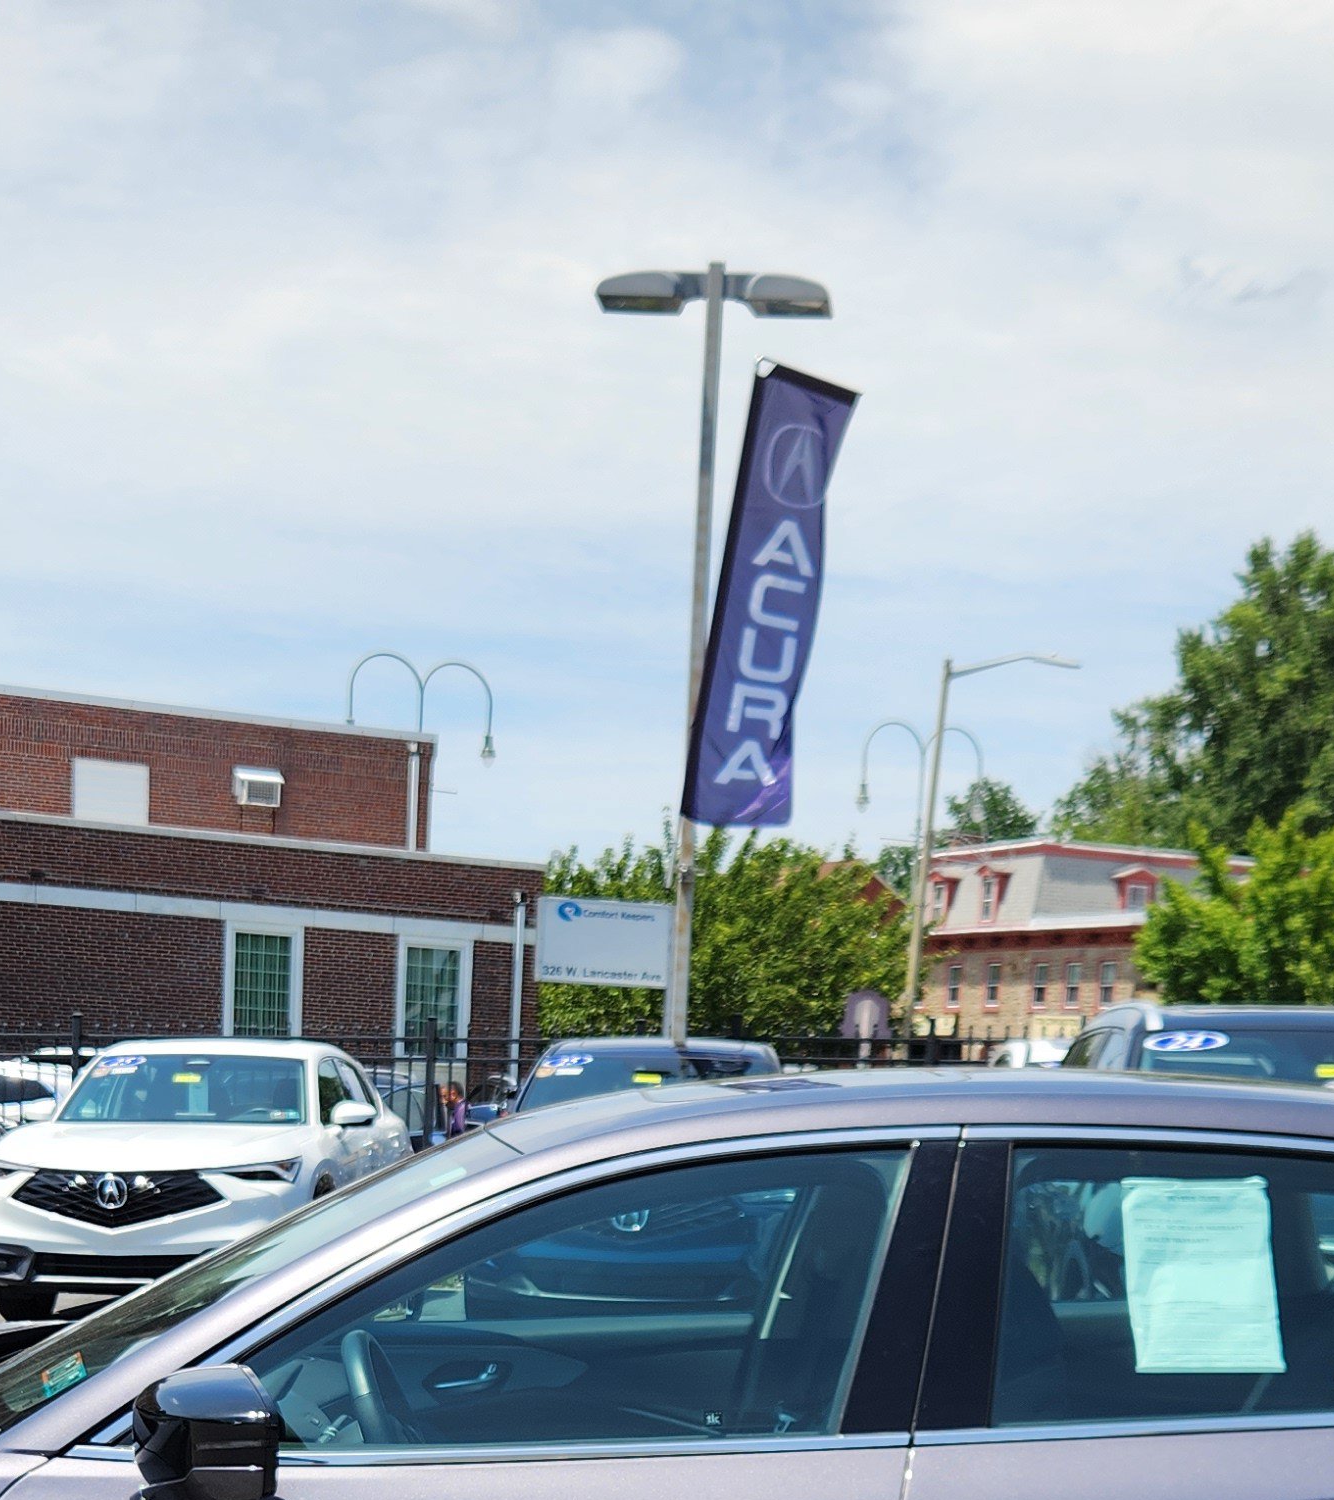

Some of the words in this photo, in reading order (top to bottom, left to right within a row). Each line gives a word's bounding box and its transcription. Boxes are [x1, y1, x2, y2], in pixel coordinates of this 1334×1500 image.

[713, 519, 815, 788] ACURA
[583, 909, 618, 919] Comfort
[583, 969, 638, 980] Lancaster
